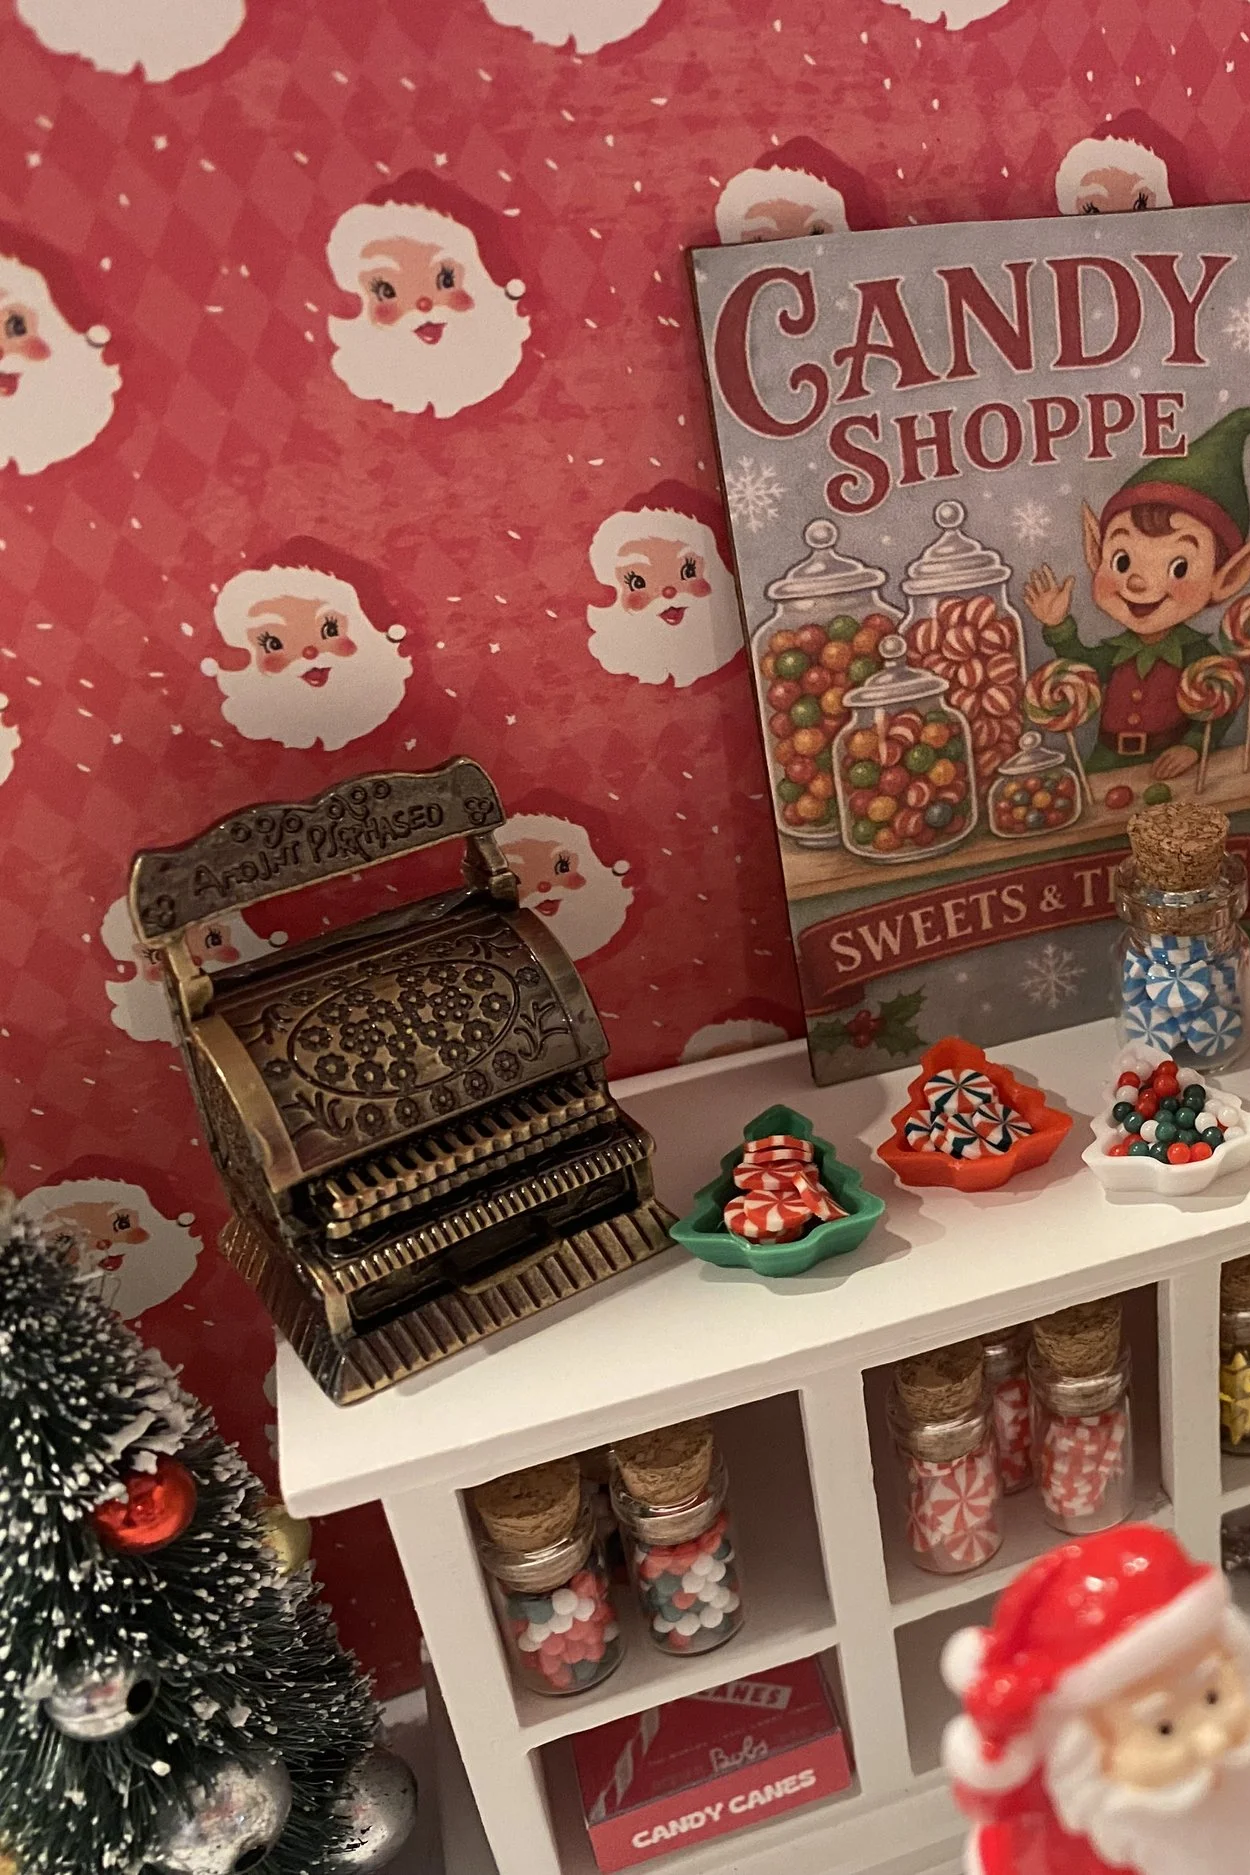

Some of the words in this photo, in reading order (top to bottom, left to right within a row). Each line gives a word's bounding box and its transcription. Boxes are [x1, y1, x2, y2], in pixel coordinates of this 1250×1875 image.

[712, 251, 1237, 439] CANDY
[824, 392, 1188, 515] SHOPPE
[829, 881, 1028, 973] SWEETS
[1038, 882, 1066, 912] &
[632, 1802, 724, 1848] CANDY
[728, 1769, 817, 1814] CANES
